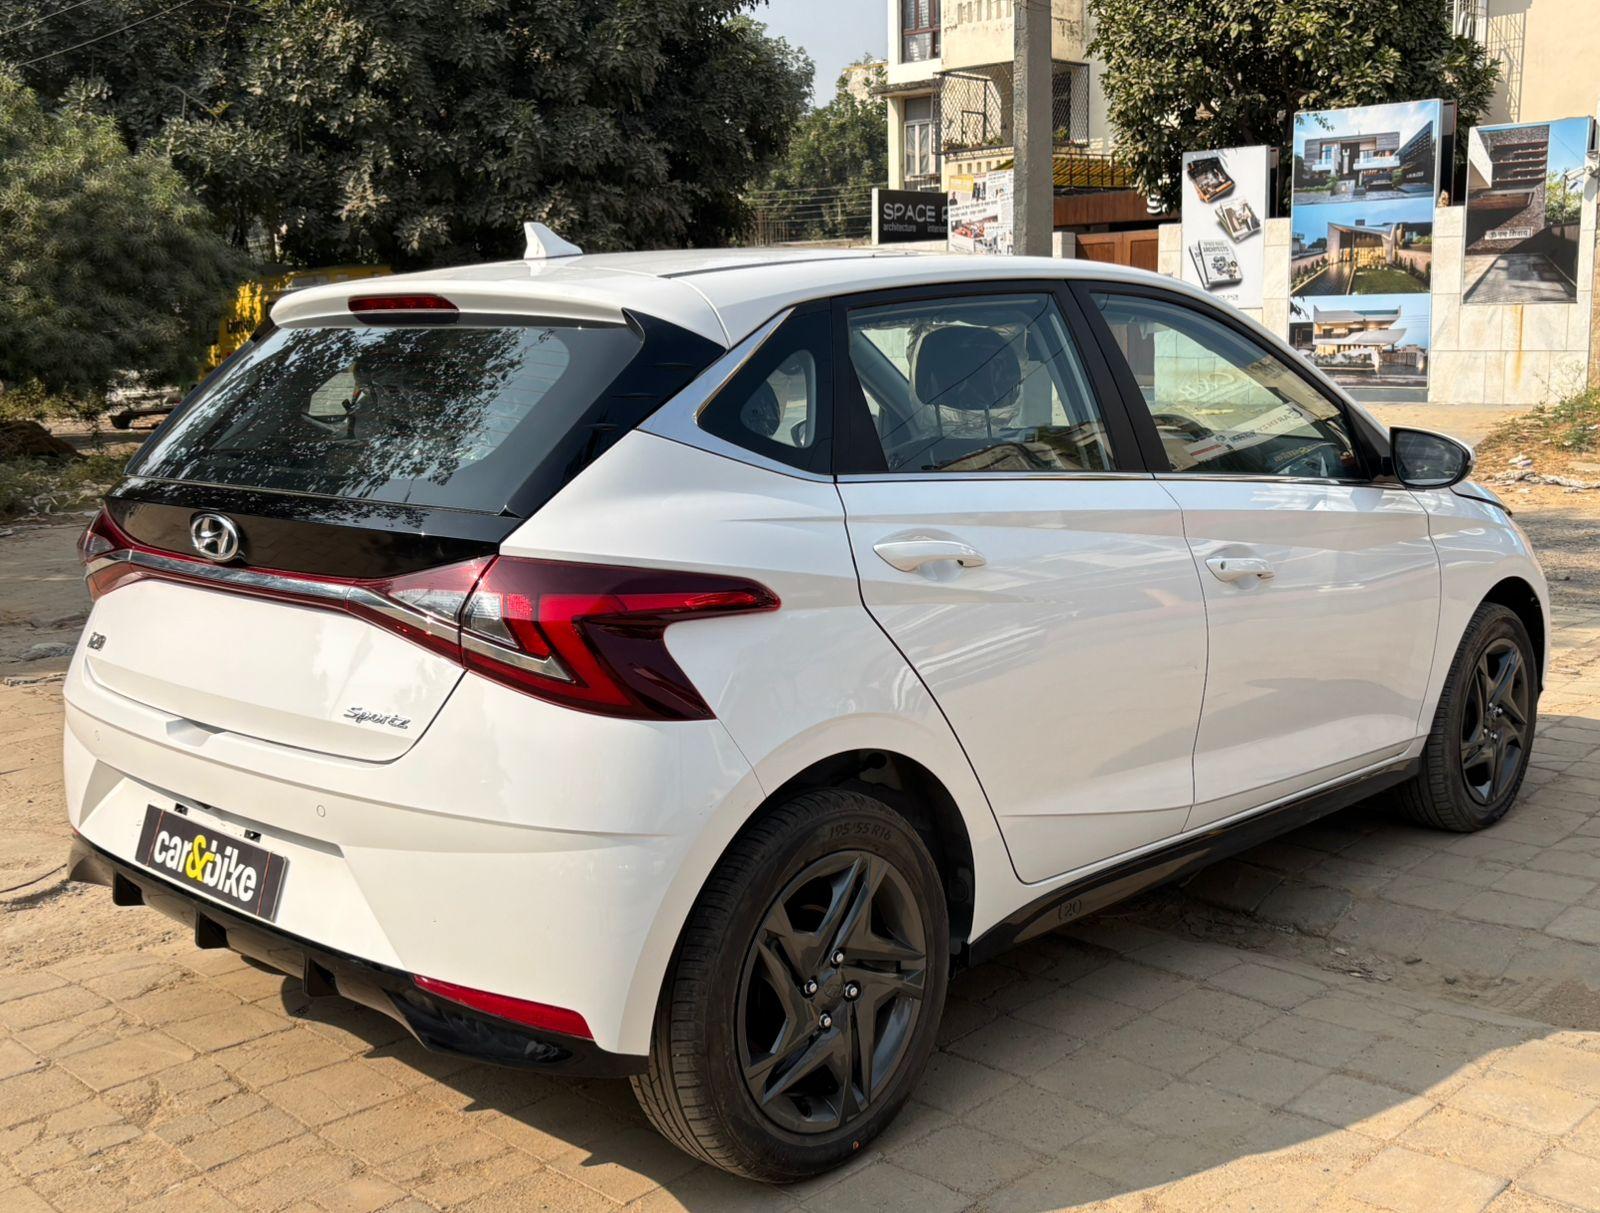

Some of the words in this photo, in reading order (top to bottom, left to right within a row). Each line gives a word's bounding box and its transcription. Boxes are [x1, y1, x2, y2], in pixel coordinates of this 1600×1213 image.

[883, 202, 936, 222] SPACE
[883, 222, 916, 233] architecture
[153, 830, 257, 902] car&bike
